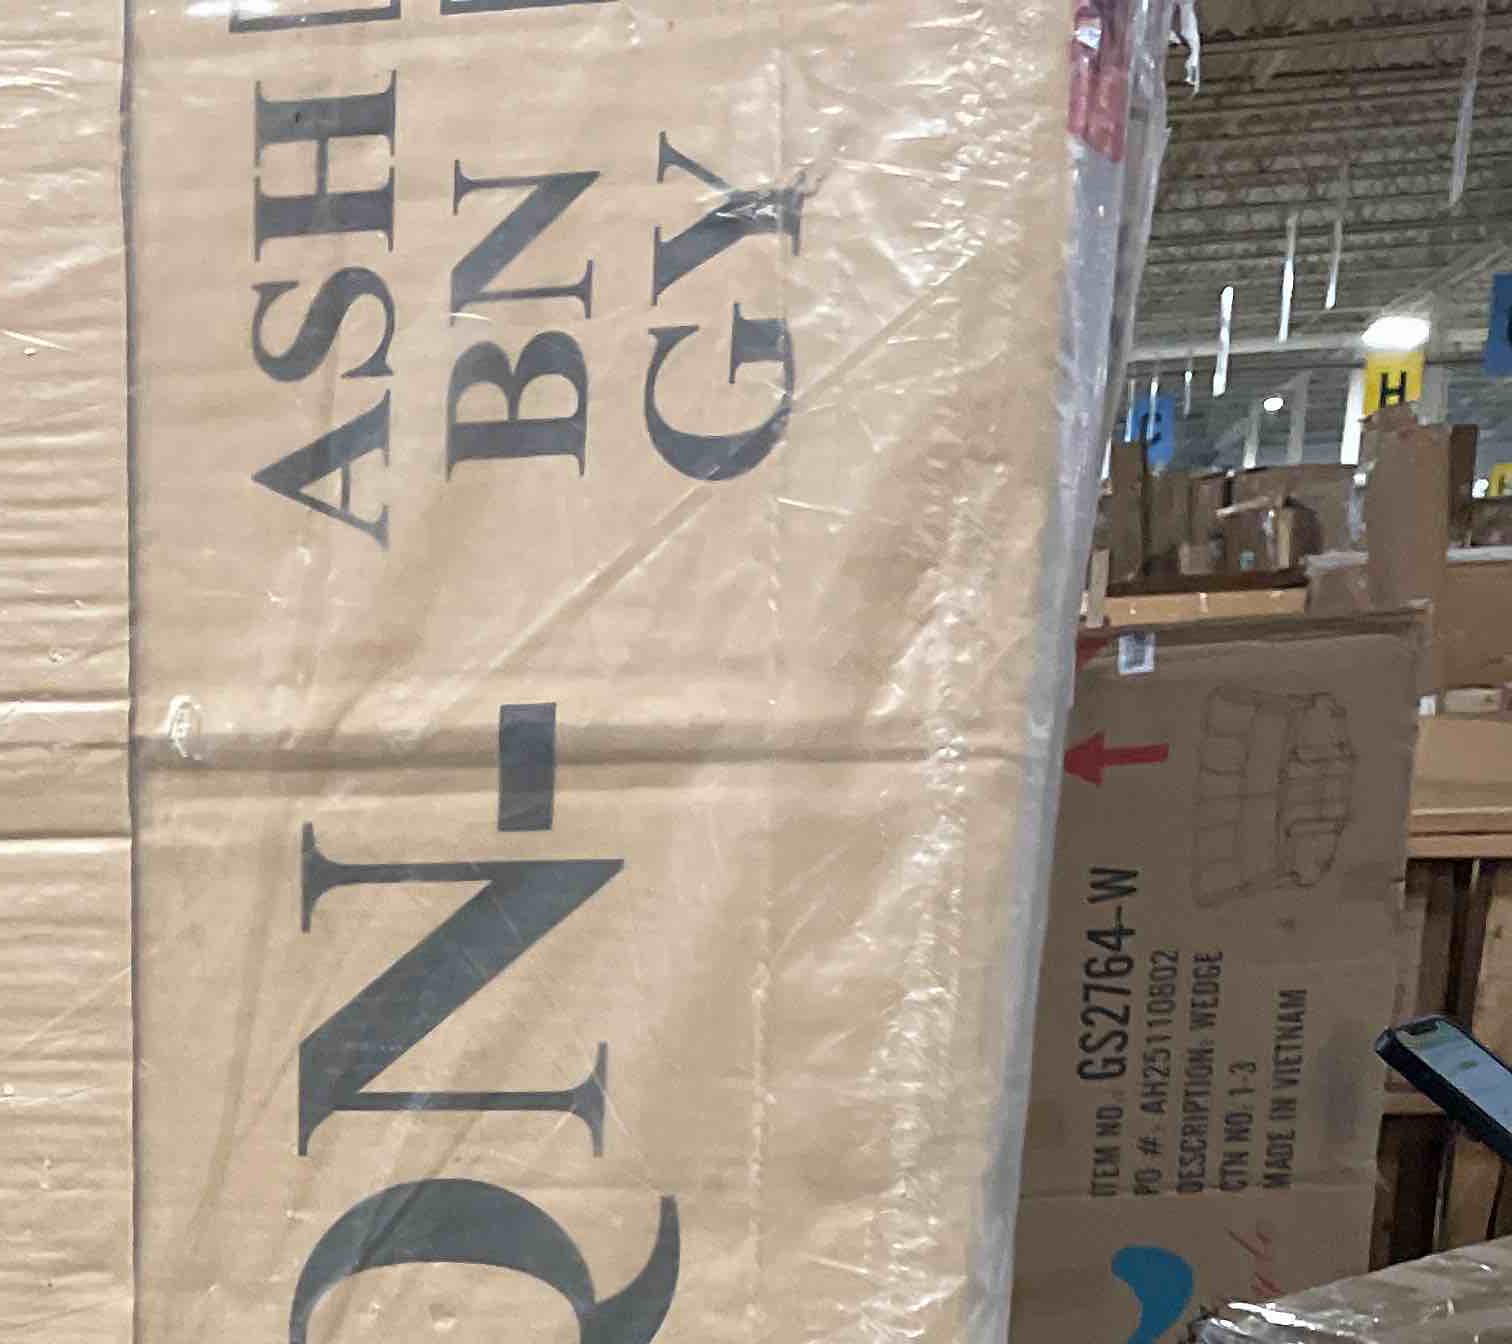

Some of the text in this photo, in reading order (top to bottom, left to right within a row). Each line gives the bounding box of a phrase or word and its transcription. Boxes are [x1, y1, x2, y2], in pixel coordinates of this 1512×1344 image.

[250, 69, 397, 551] ASH
[445, 159, 601, 482] BN
[644, 130, 806, 483] GY
[1379, 370, 1408, 407] H
[1076, 866, 1139, 1081] GS2764-W
[1189, 950, 1224, 1032] WEDGE
[1090, 1147, 1121, 1198] ITEM
[1219, 1152, 1249, 1192] CTN
[1263, 988, 1308, 1190] MADE IN VIETNAM
